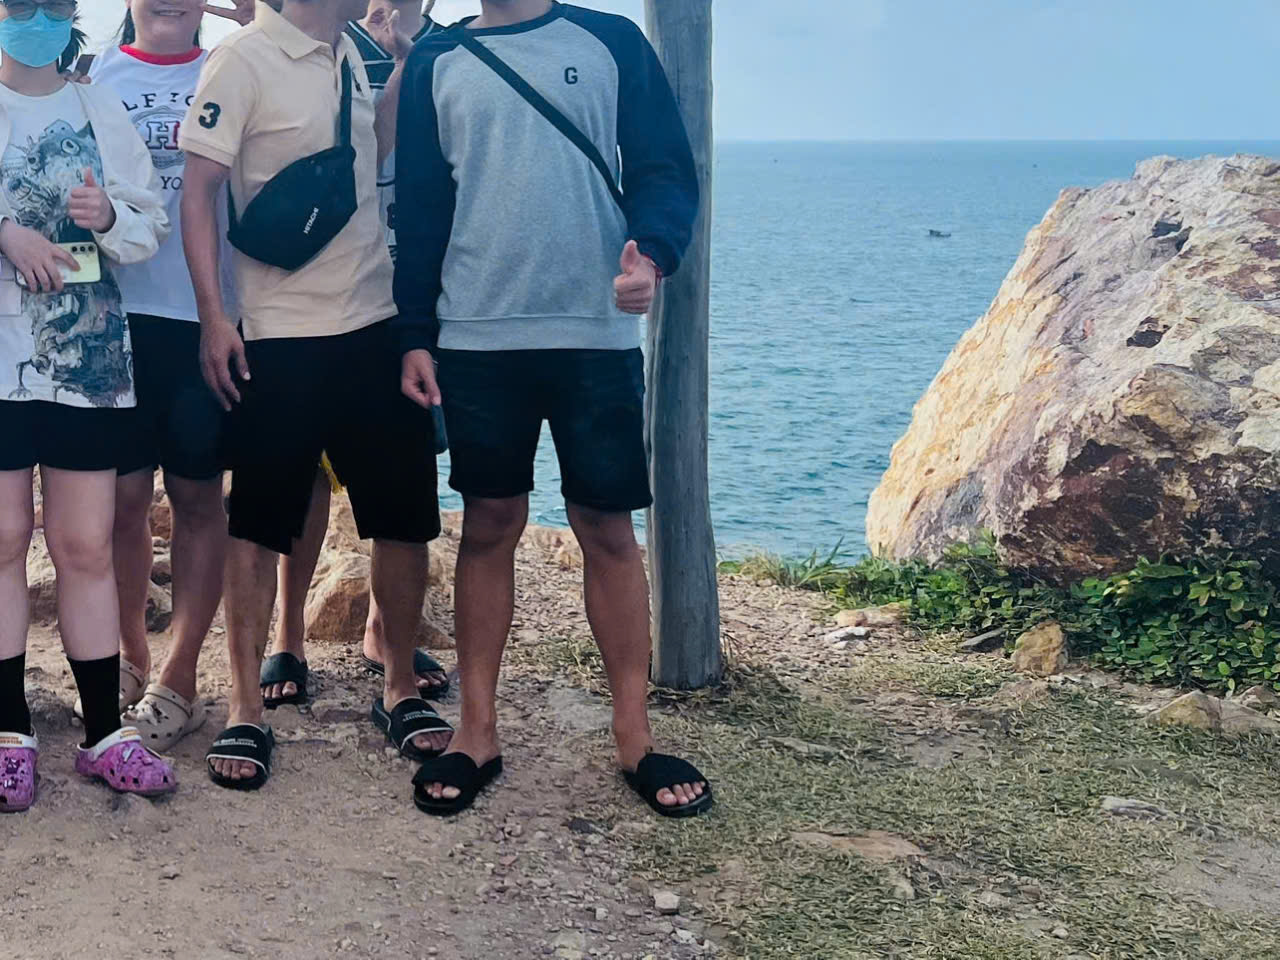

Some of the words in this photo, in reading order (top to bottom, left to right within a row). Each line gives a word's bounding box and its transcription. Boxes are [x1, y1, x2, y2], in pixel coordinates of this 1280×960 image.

[564, 66, 579, 85] G
[198, 101, 221, 129] 3
[145, 120, 181, 150] H
